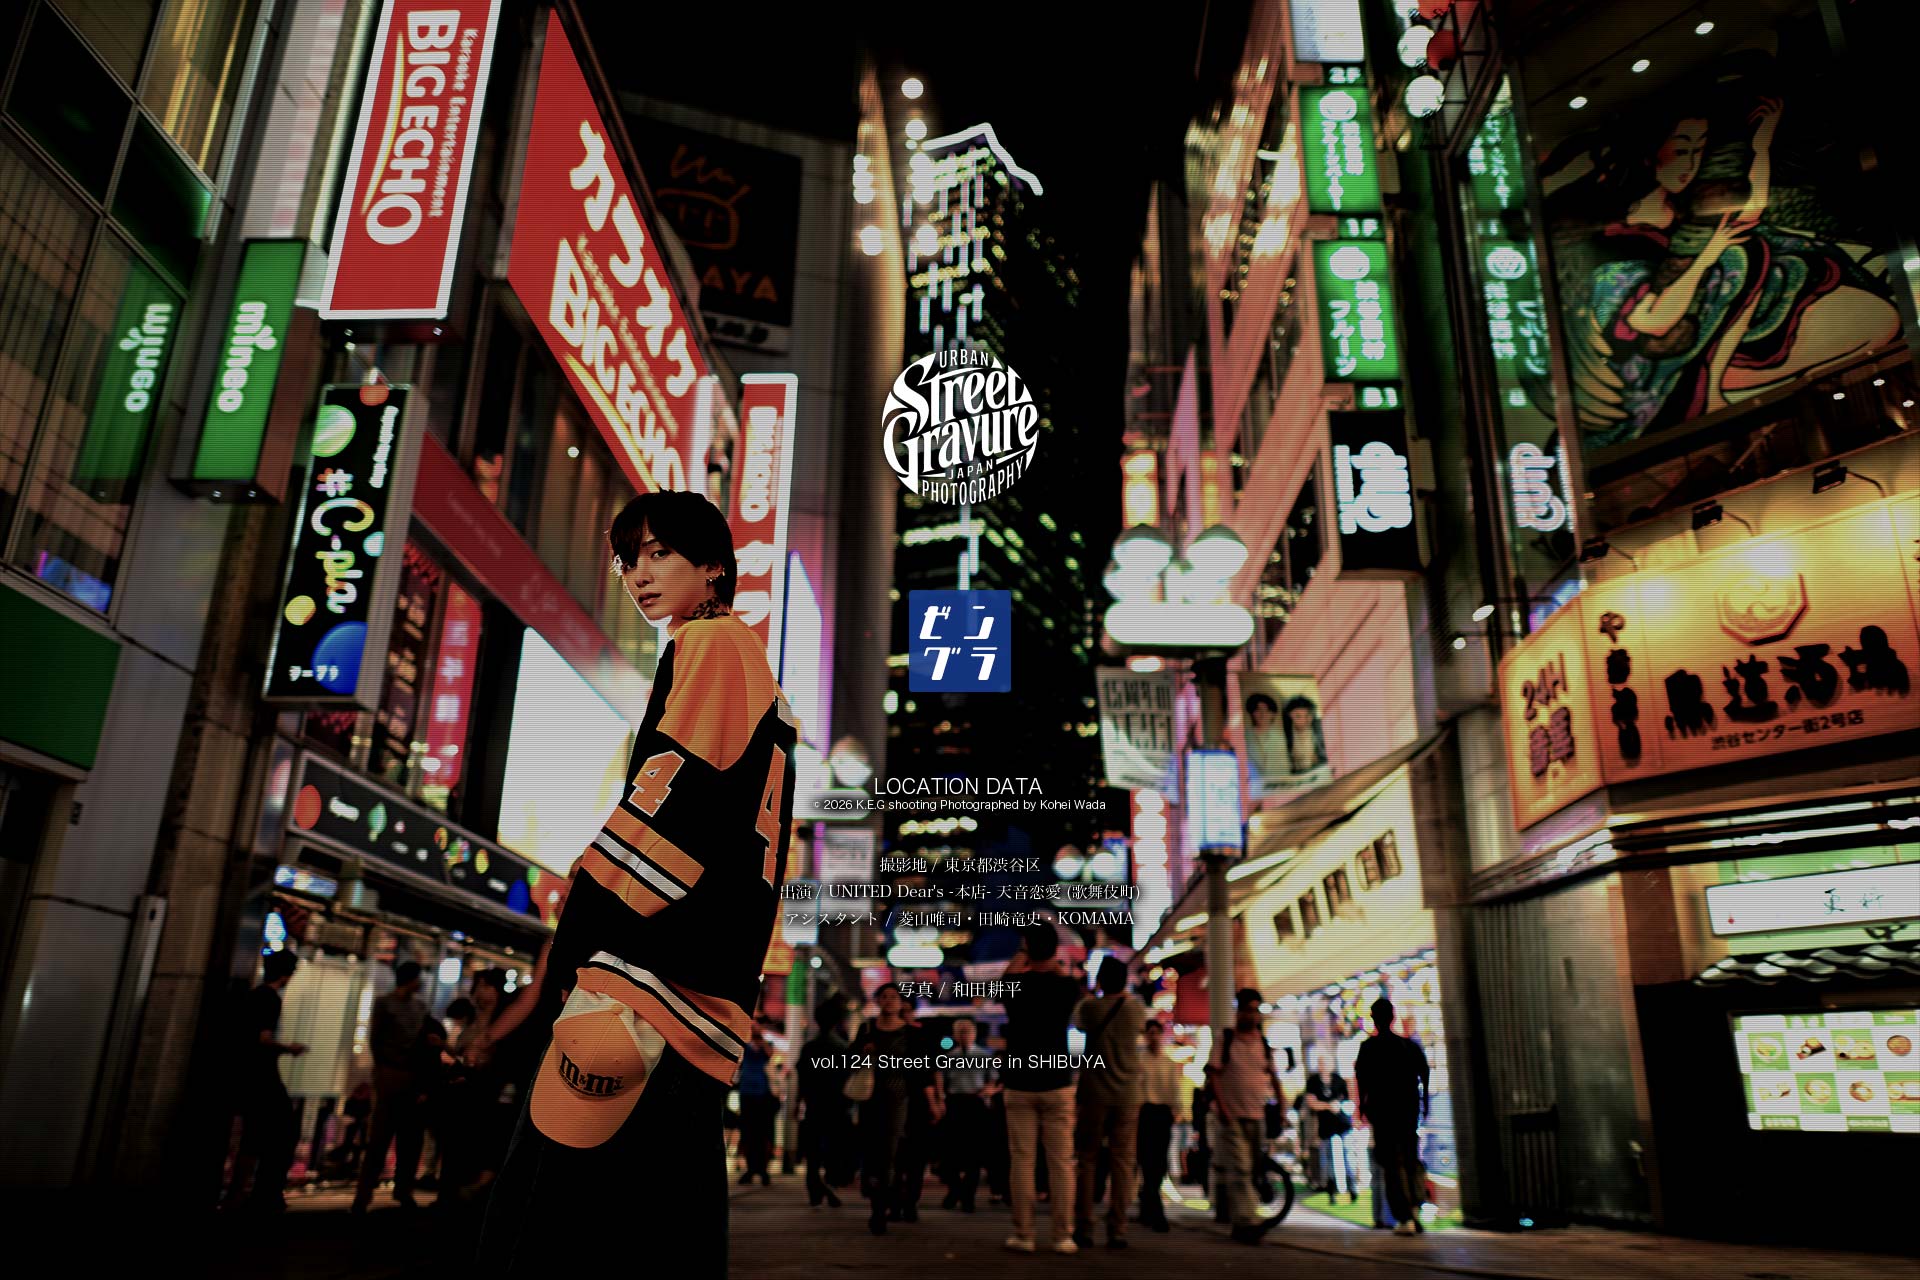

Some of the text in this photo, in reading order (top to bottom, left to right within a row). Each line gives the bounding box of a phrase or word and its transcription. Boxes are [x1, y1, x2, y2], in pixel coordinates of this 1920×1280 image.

[366, 10, 461, 245] BIG ECHO
[217, 301, 278, 412] mineo
[311, 468, 375, 613] #C-pla
[627, 750, 686, 818] 4
[1712, 709, 1865, 750] 渋谷センター街2号店
[755, 743, 787, 890] 4
